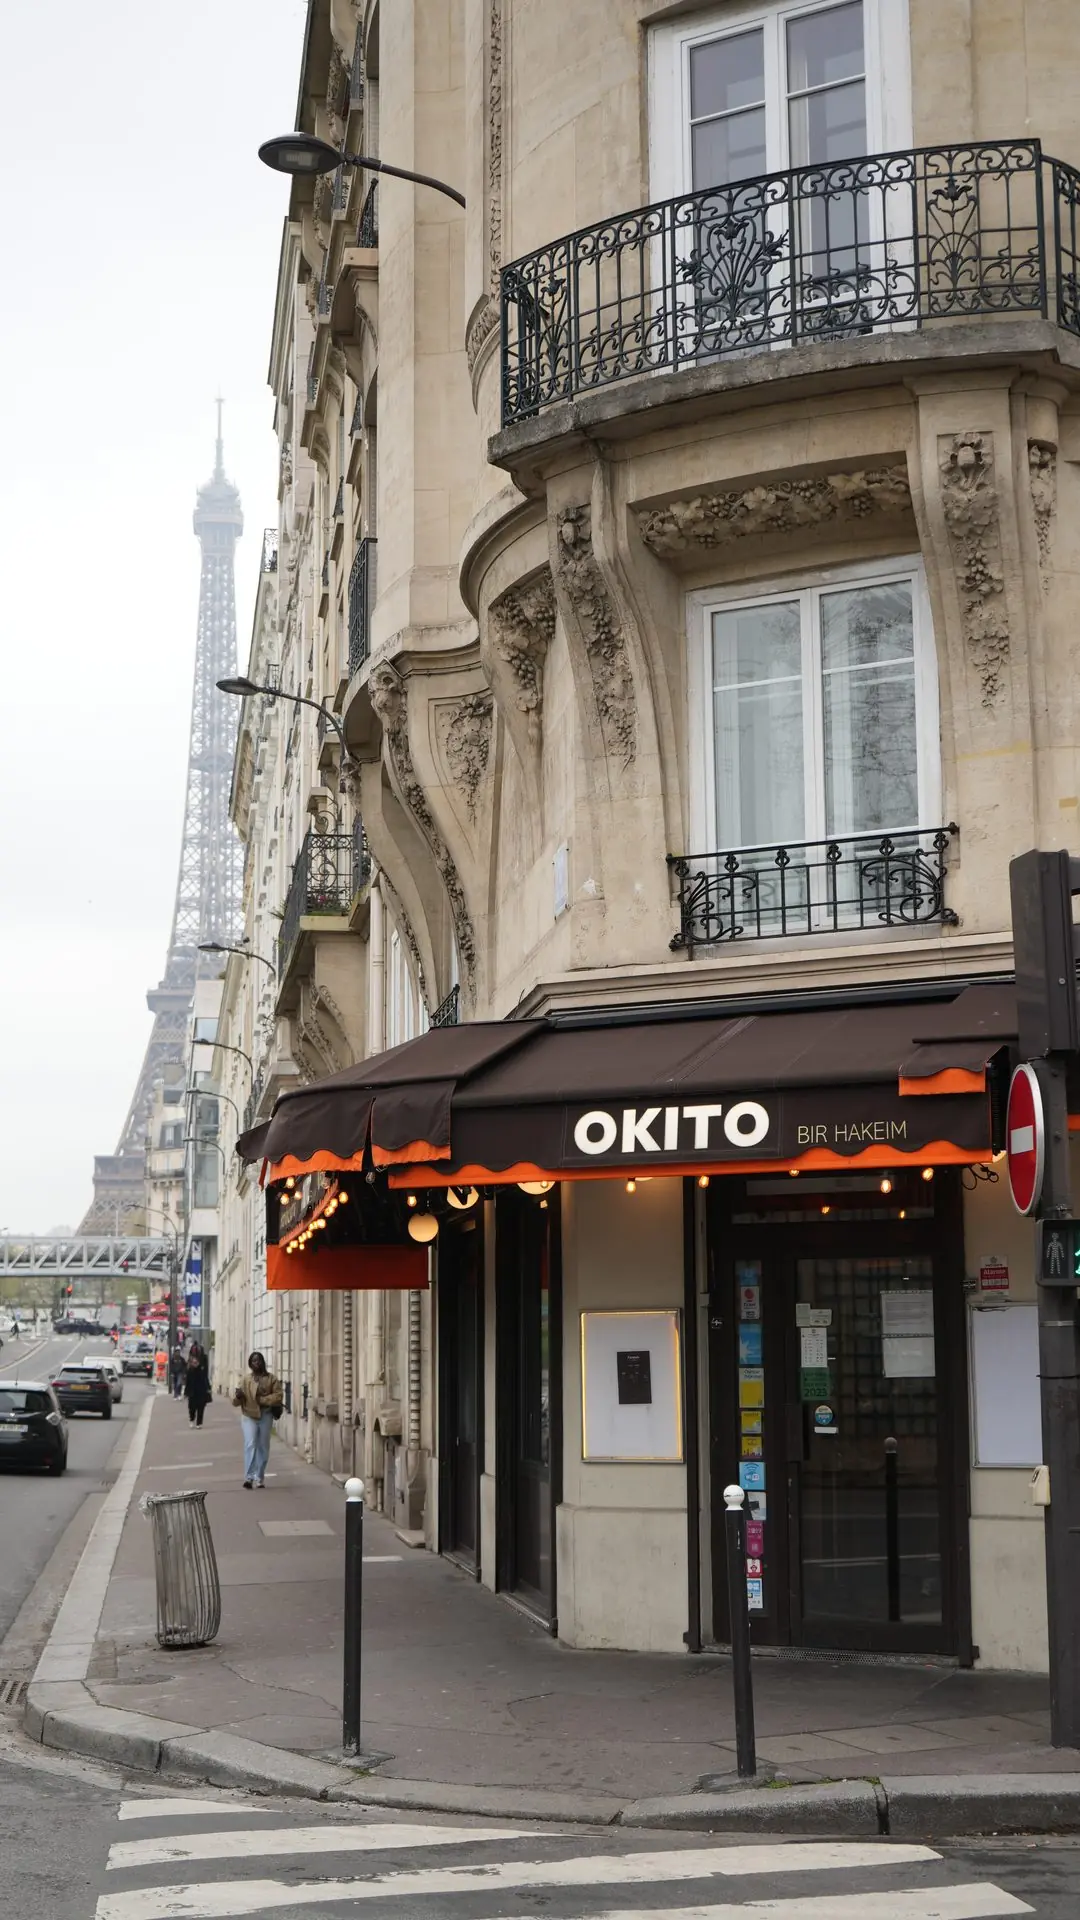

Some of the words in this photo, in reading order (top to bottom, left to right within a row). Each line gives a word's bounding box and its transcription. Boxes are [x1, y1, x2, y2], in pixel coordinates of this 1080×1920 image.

[574, 1101, 769, 1155] OKITO
[797, 1125, 828, 1144] BIR
[835, 1120, 907, 1142] HAKEIM
[804, 1388, 828, 1397] 2023
